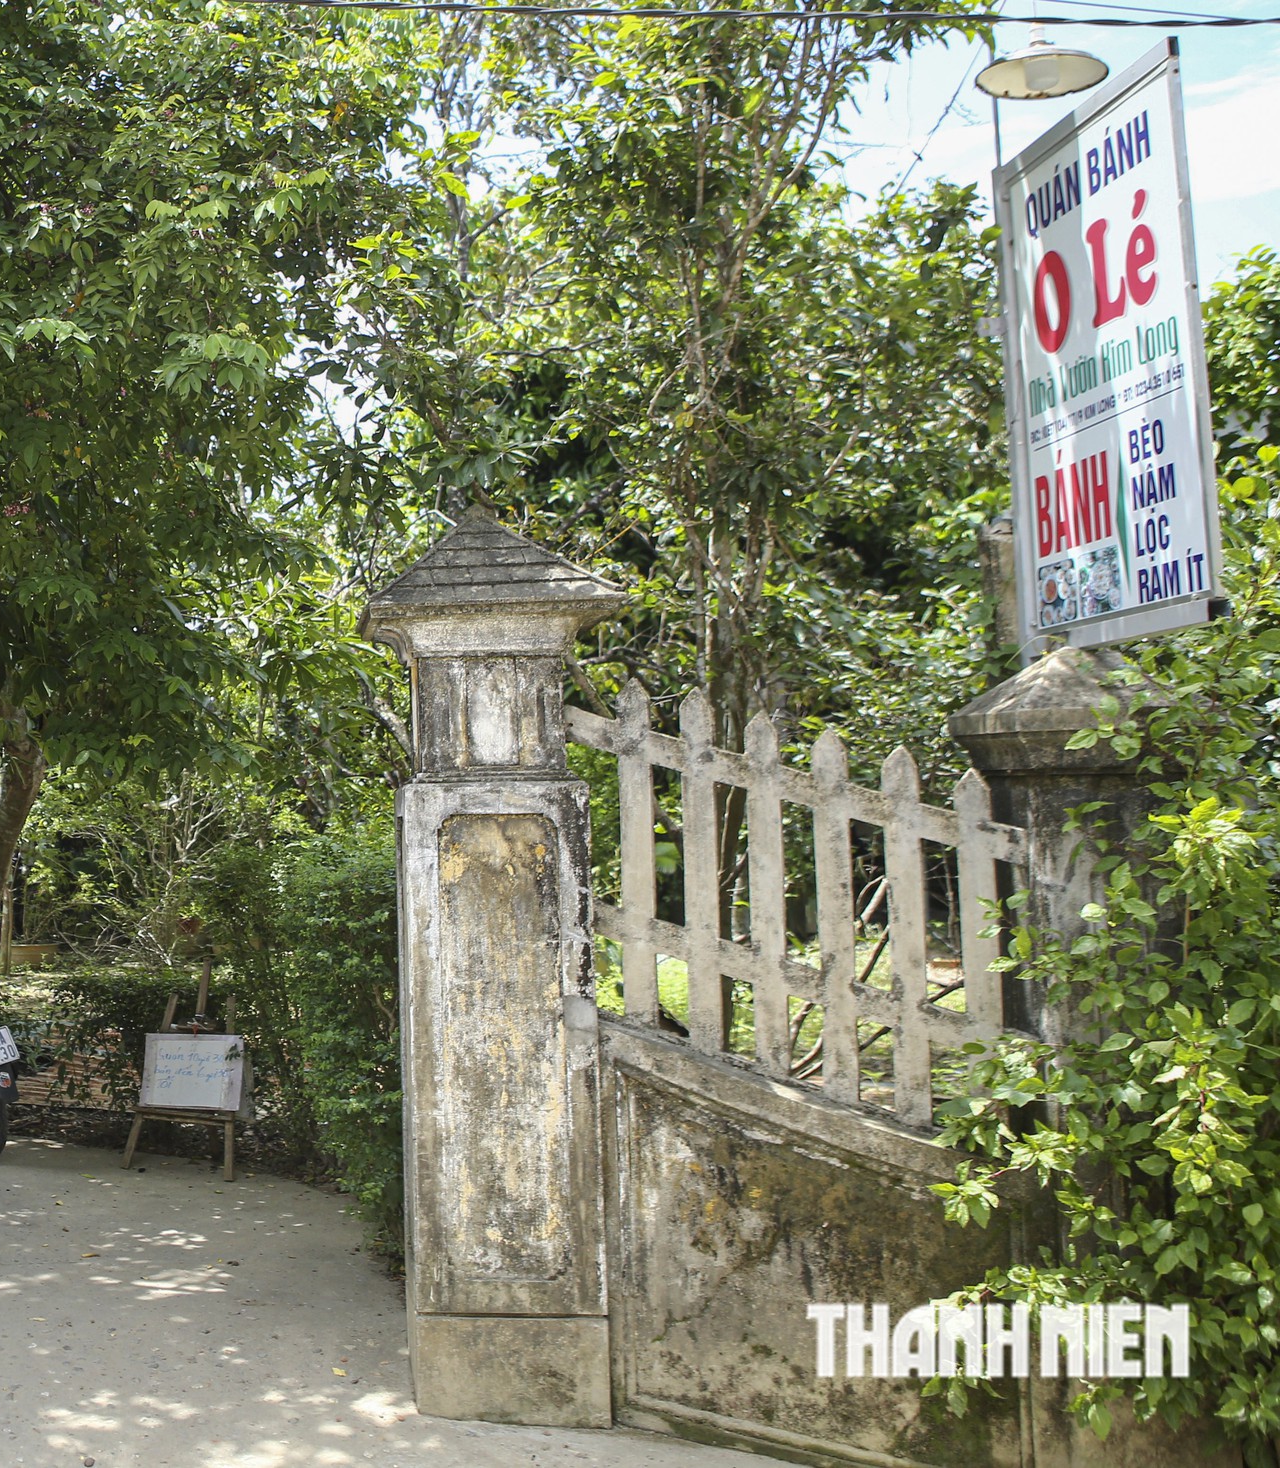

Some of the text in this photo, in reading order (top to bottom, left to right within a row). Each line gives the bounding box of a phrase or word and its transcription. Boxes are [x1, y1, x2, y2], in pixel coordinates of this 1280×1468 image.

[1024, 110, 1151, 240] QUÁN BÁNH
[1033, 188, 1157, 354] O Lé
[1100, 338, 1132, 383] Kim
[1136, 315, 1180, 365] Long
[1128, 417, 1165, 464] BÈO
[1035, 449, 1112, 559] BÁNH
[1131, 463, 1176, 514] NẬM
[1135, 514, 1170, 562] LỌC
[1187, 548, 1204, 594] ÍT
